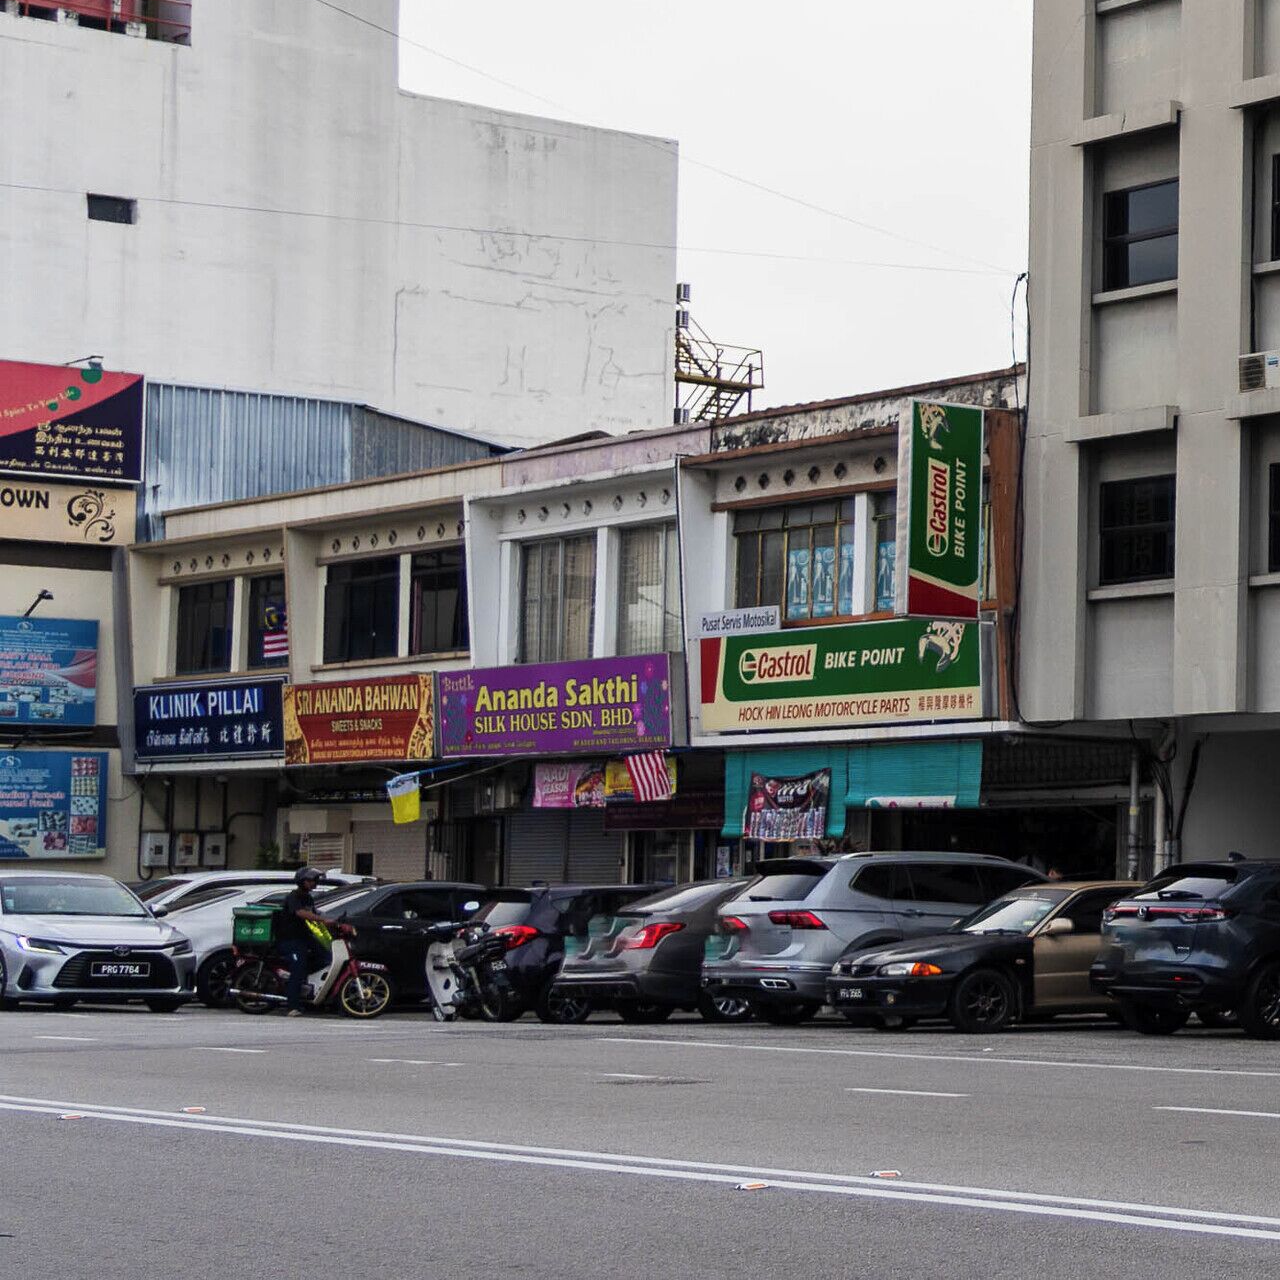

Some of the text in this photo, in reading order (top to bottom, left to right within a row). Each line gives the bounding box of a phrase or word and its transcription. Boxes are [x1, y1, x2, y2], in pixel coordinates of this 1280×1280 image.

[930, 465, 947, 533] Castrol
[954, 458, 967, 558] BIKE POINT
[701, 609, 777, 633] Pusat Servis Motosikal
[757, 647, 905, 679] Castrol BIKE POINT
[150, 688, 259, 719] KLINIK PILLAI
[297, 684, 418, 715] SRI ANANDA BAHWAN
[475, 674, 638, 712] Ananda Sakthi
[475, 708, 637, 734] SILK HOUSE SDN. BHD.
[738, 697, 910, 721] HOCK HIN LEONG MOTORCYCLE PARTS
[331, 719, 353, 733] SWEETS
[360, 718, 383, 731] SNACKS
[101, 965, 118, 974] PRG
